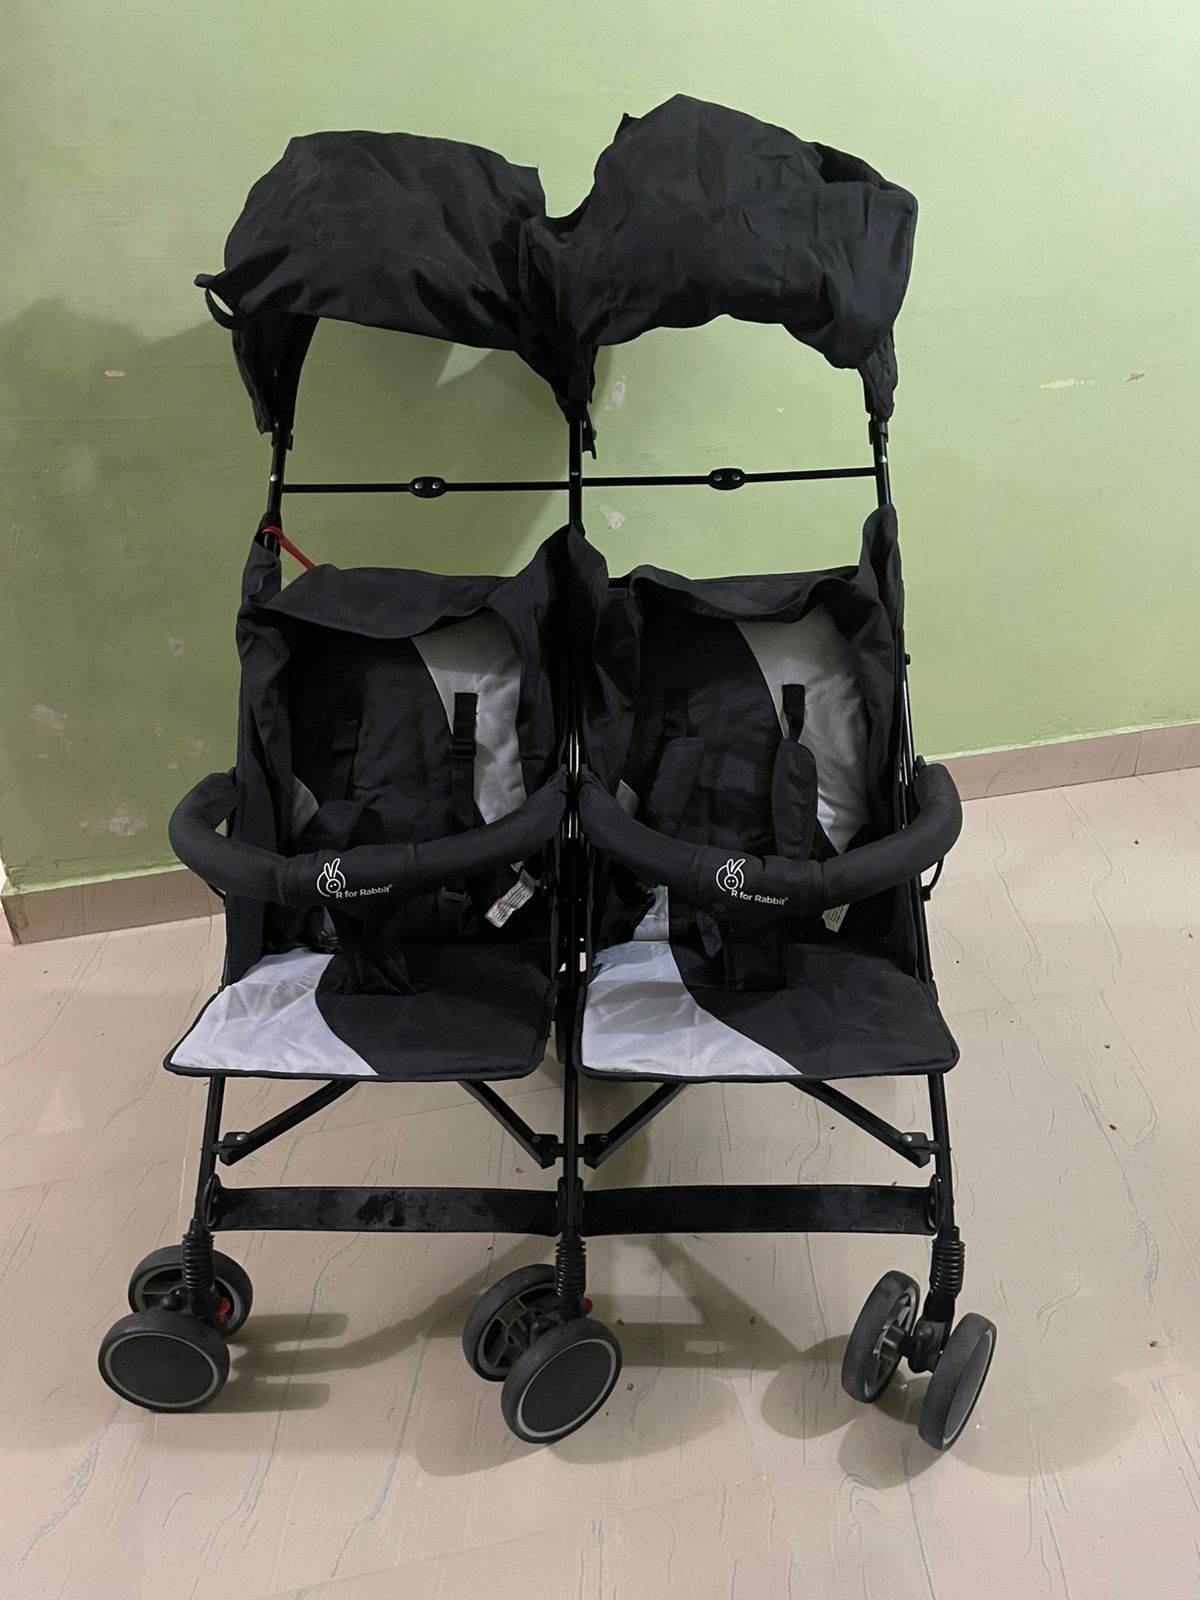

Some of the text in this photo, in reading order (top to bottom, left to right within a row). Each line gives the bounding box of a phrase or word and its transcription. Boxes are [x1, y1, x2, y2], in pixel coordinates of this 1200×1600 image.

[336, 886, 390, 899] R for Rabbit
[731, 889, 785, 905] R for Rabbit
